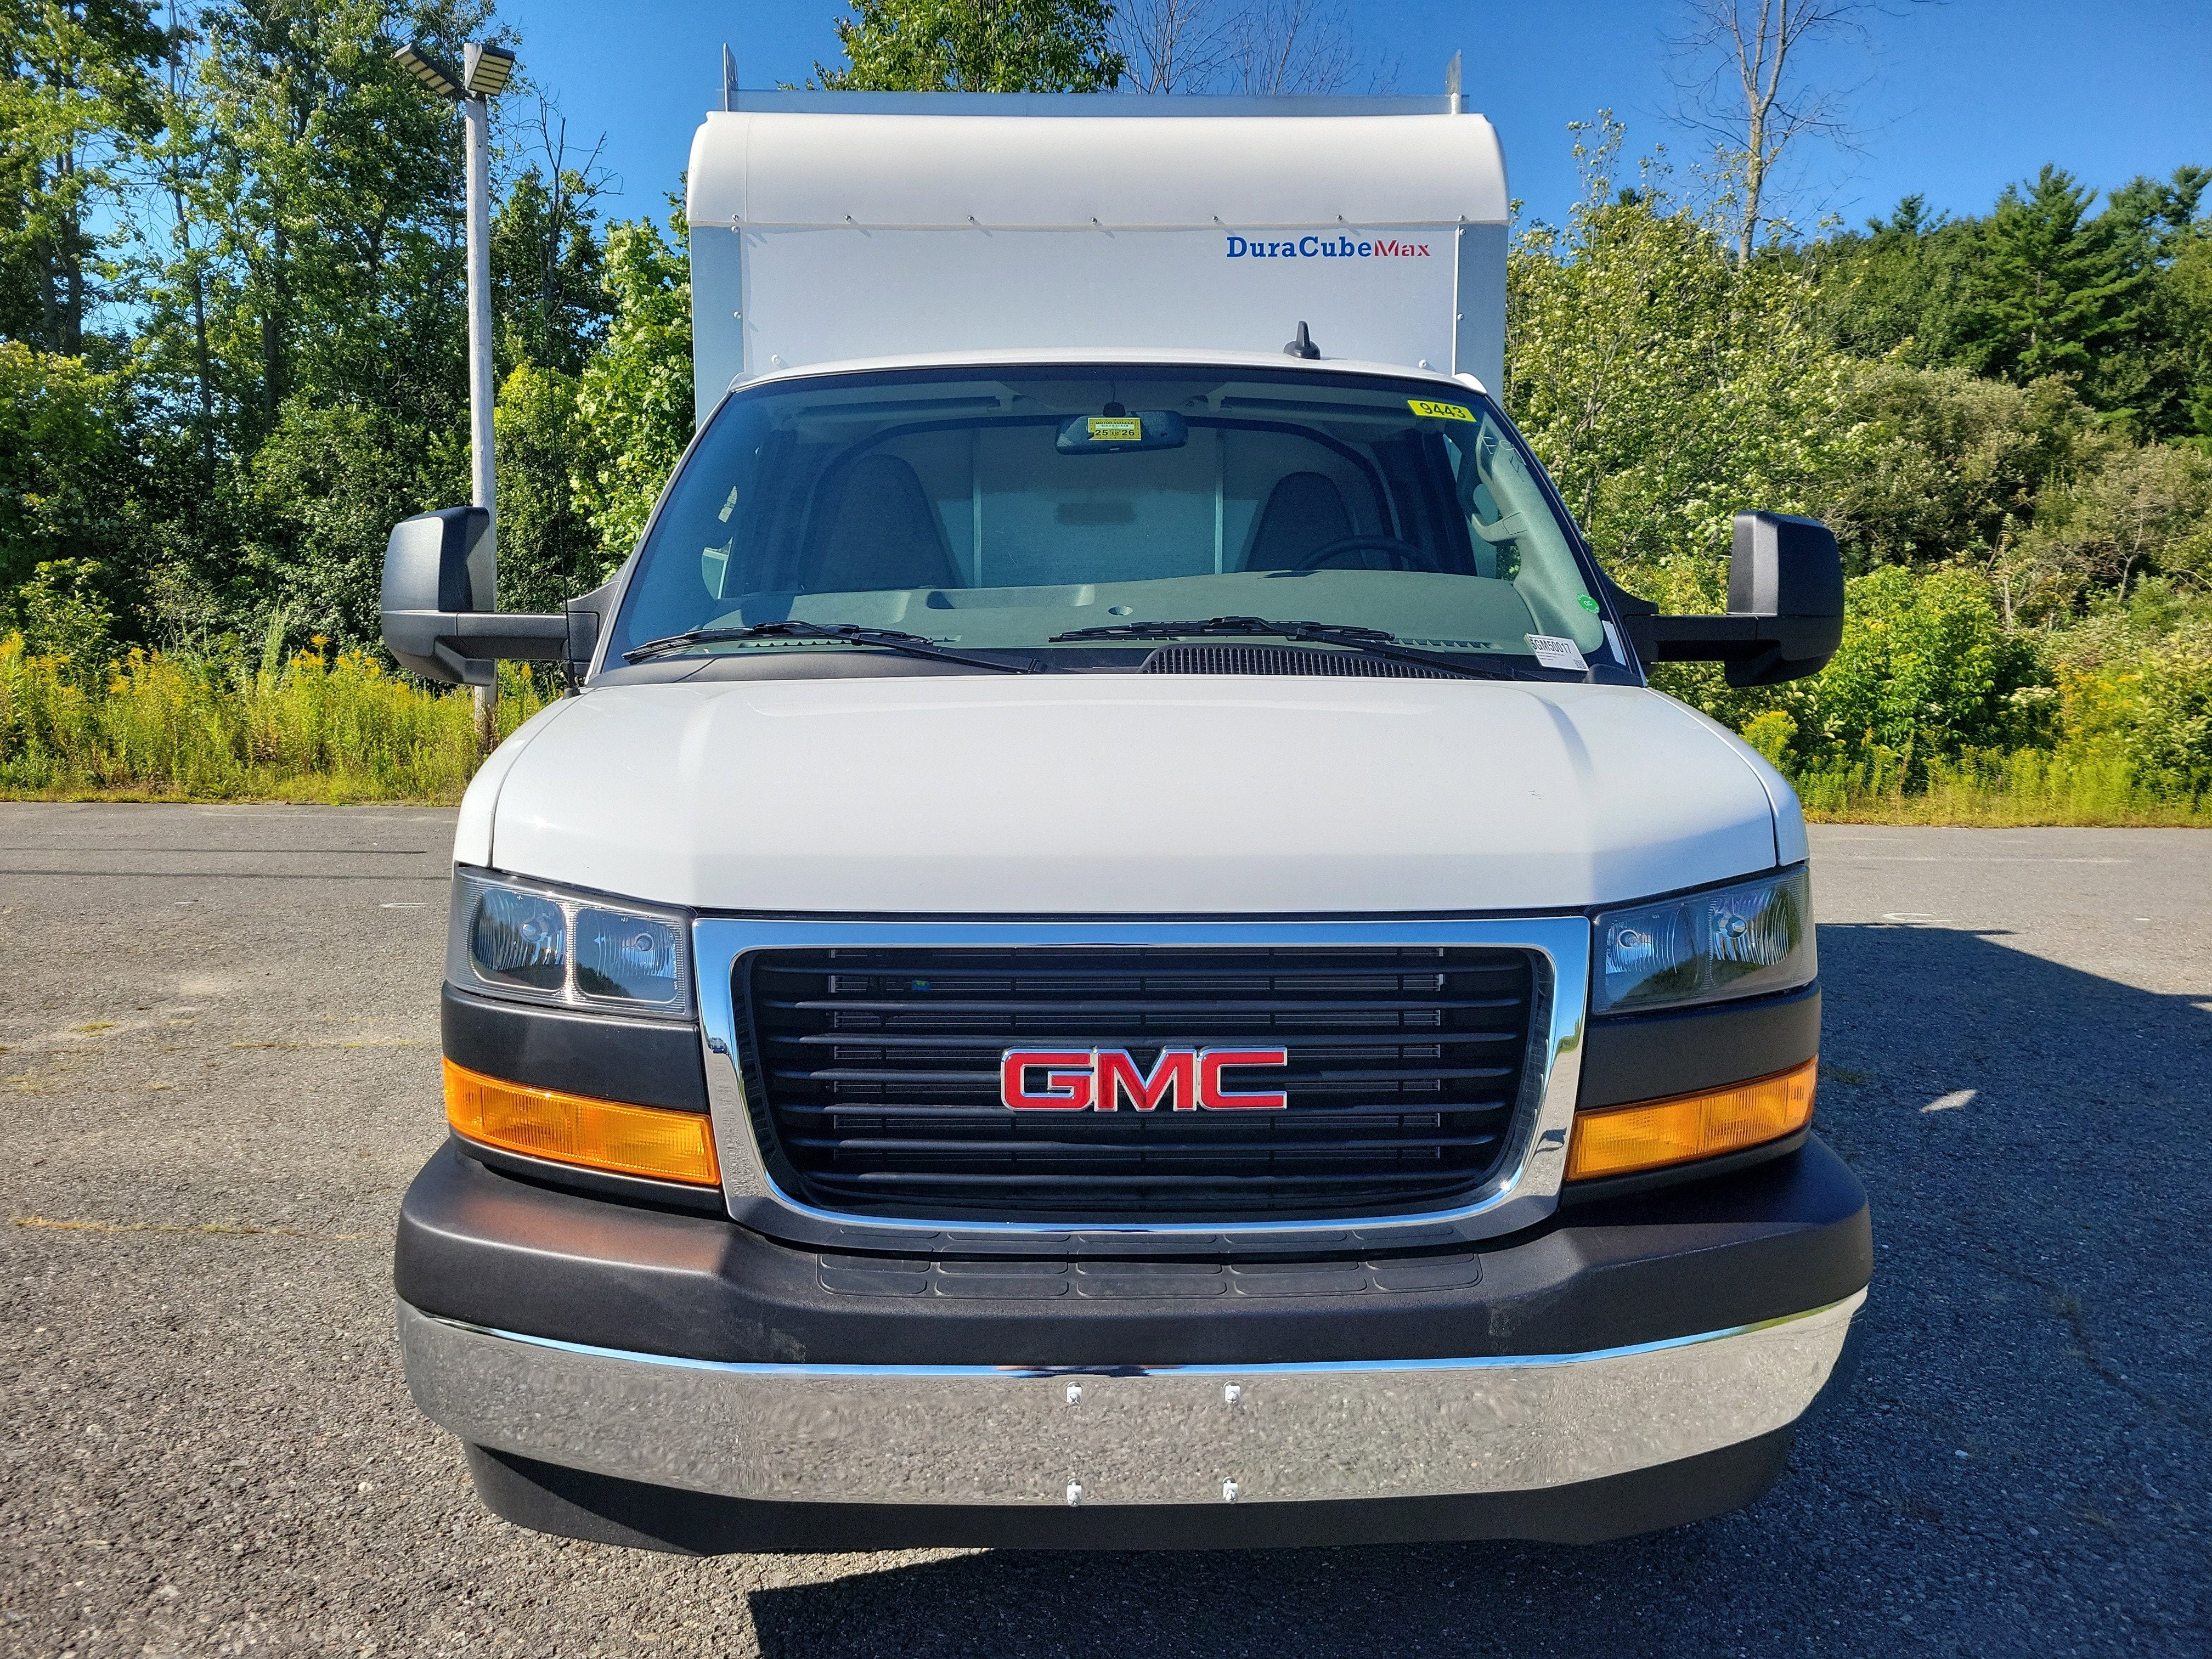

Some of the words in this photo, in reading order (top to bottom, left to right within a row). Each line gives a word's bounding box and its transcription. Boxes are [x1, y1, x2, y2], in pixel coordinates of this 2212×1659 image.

[1227, 236, 1431, 257] DuraCubeMax
[1419, 402, 1466, 419] 9443
[1000, 1046, 1288, 1112] GMC
